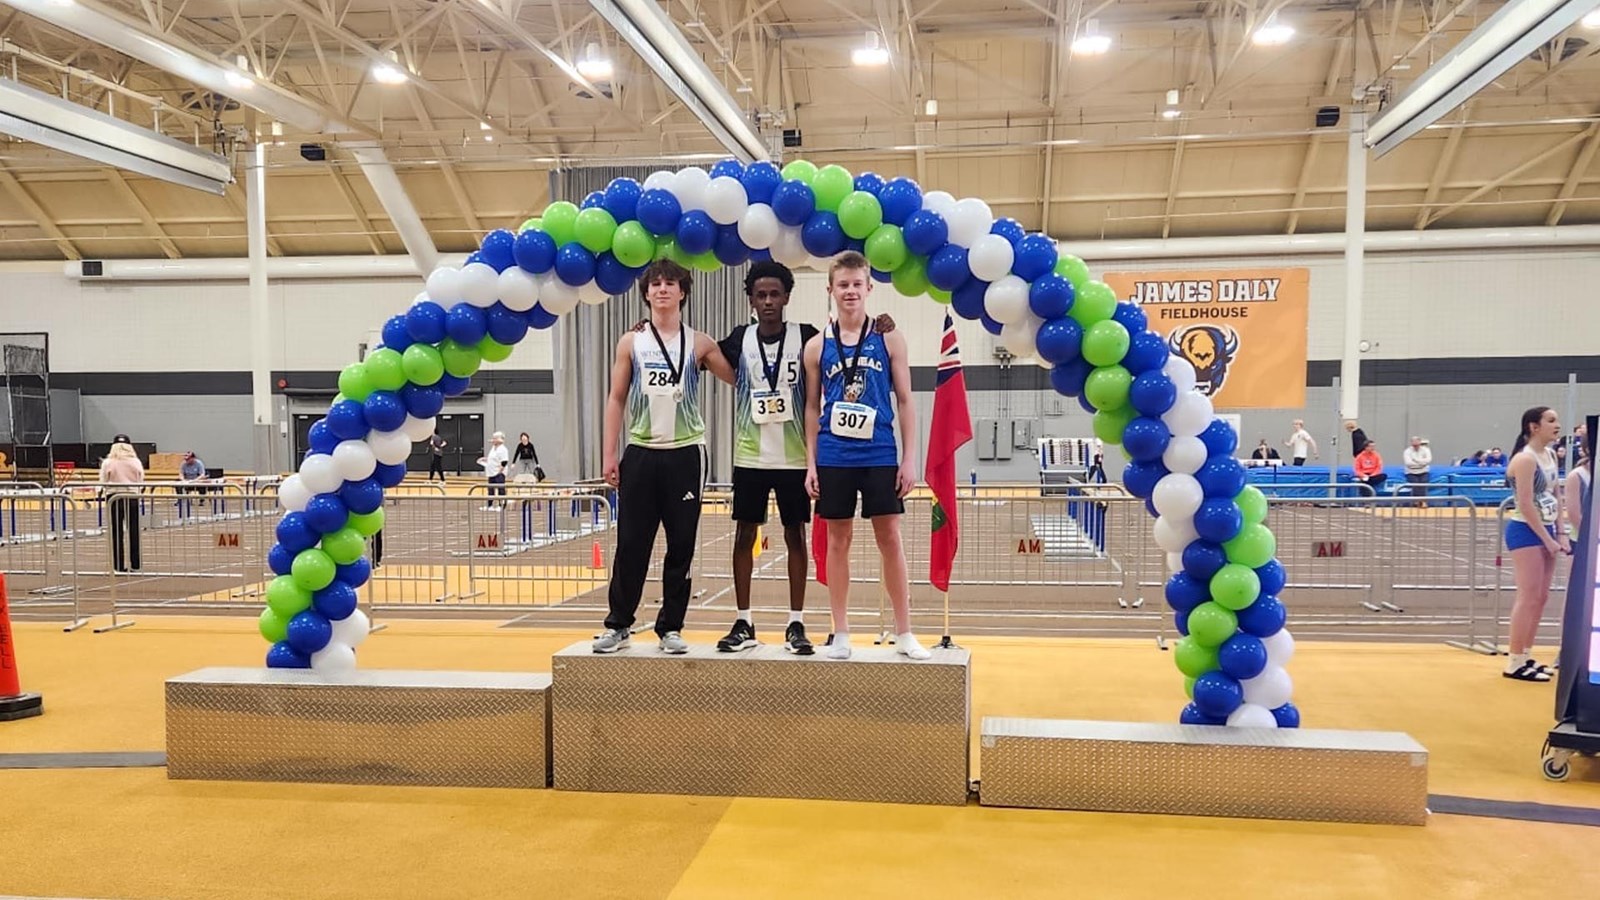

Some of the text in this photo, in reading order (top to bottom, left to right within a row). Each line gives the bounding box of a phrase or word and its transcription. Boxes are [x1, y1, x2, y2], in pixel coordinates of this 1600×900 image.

[1130, 278, 1281, 304] JAMES DALY
[1161, 306, 1249, 319] FIELDHOUSE
[648, 371, 677, 387] 284
[787, 361, 797, 383] 5
[837, 411, 868, 430] 307
[218, 533, 239, 547] AM
[478, 534, 498, 548] AM
[1017, 539, 1041, 553] AM
[1317, 541, 1342, 557] AM
